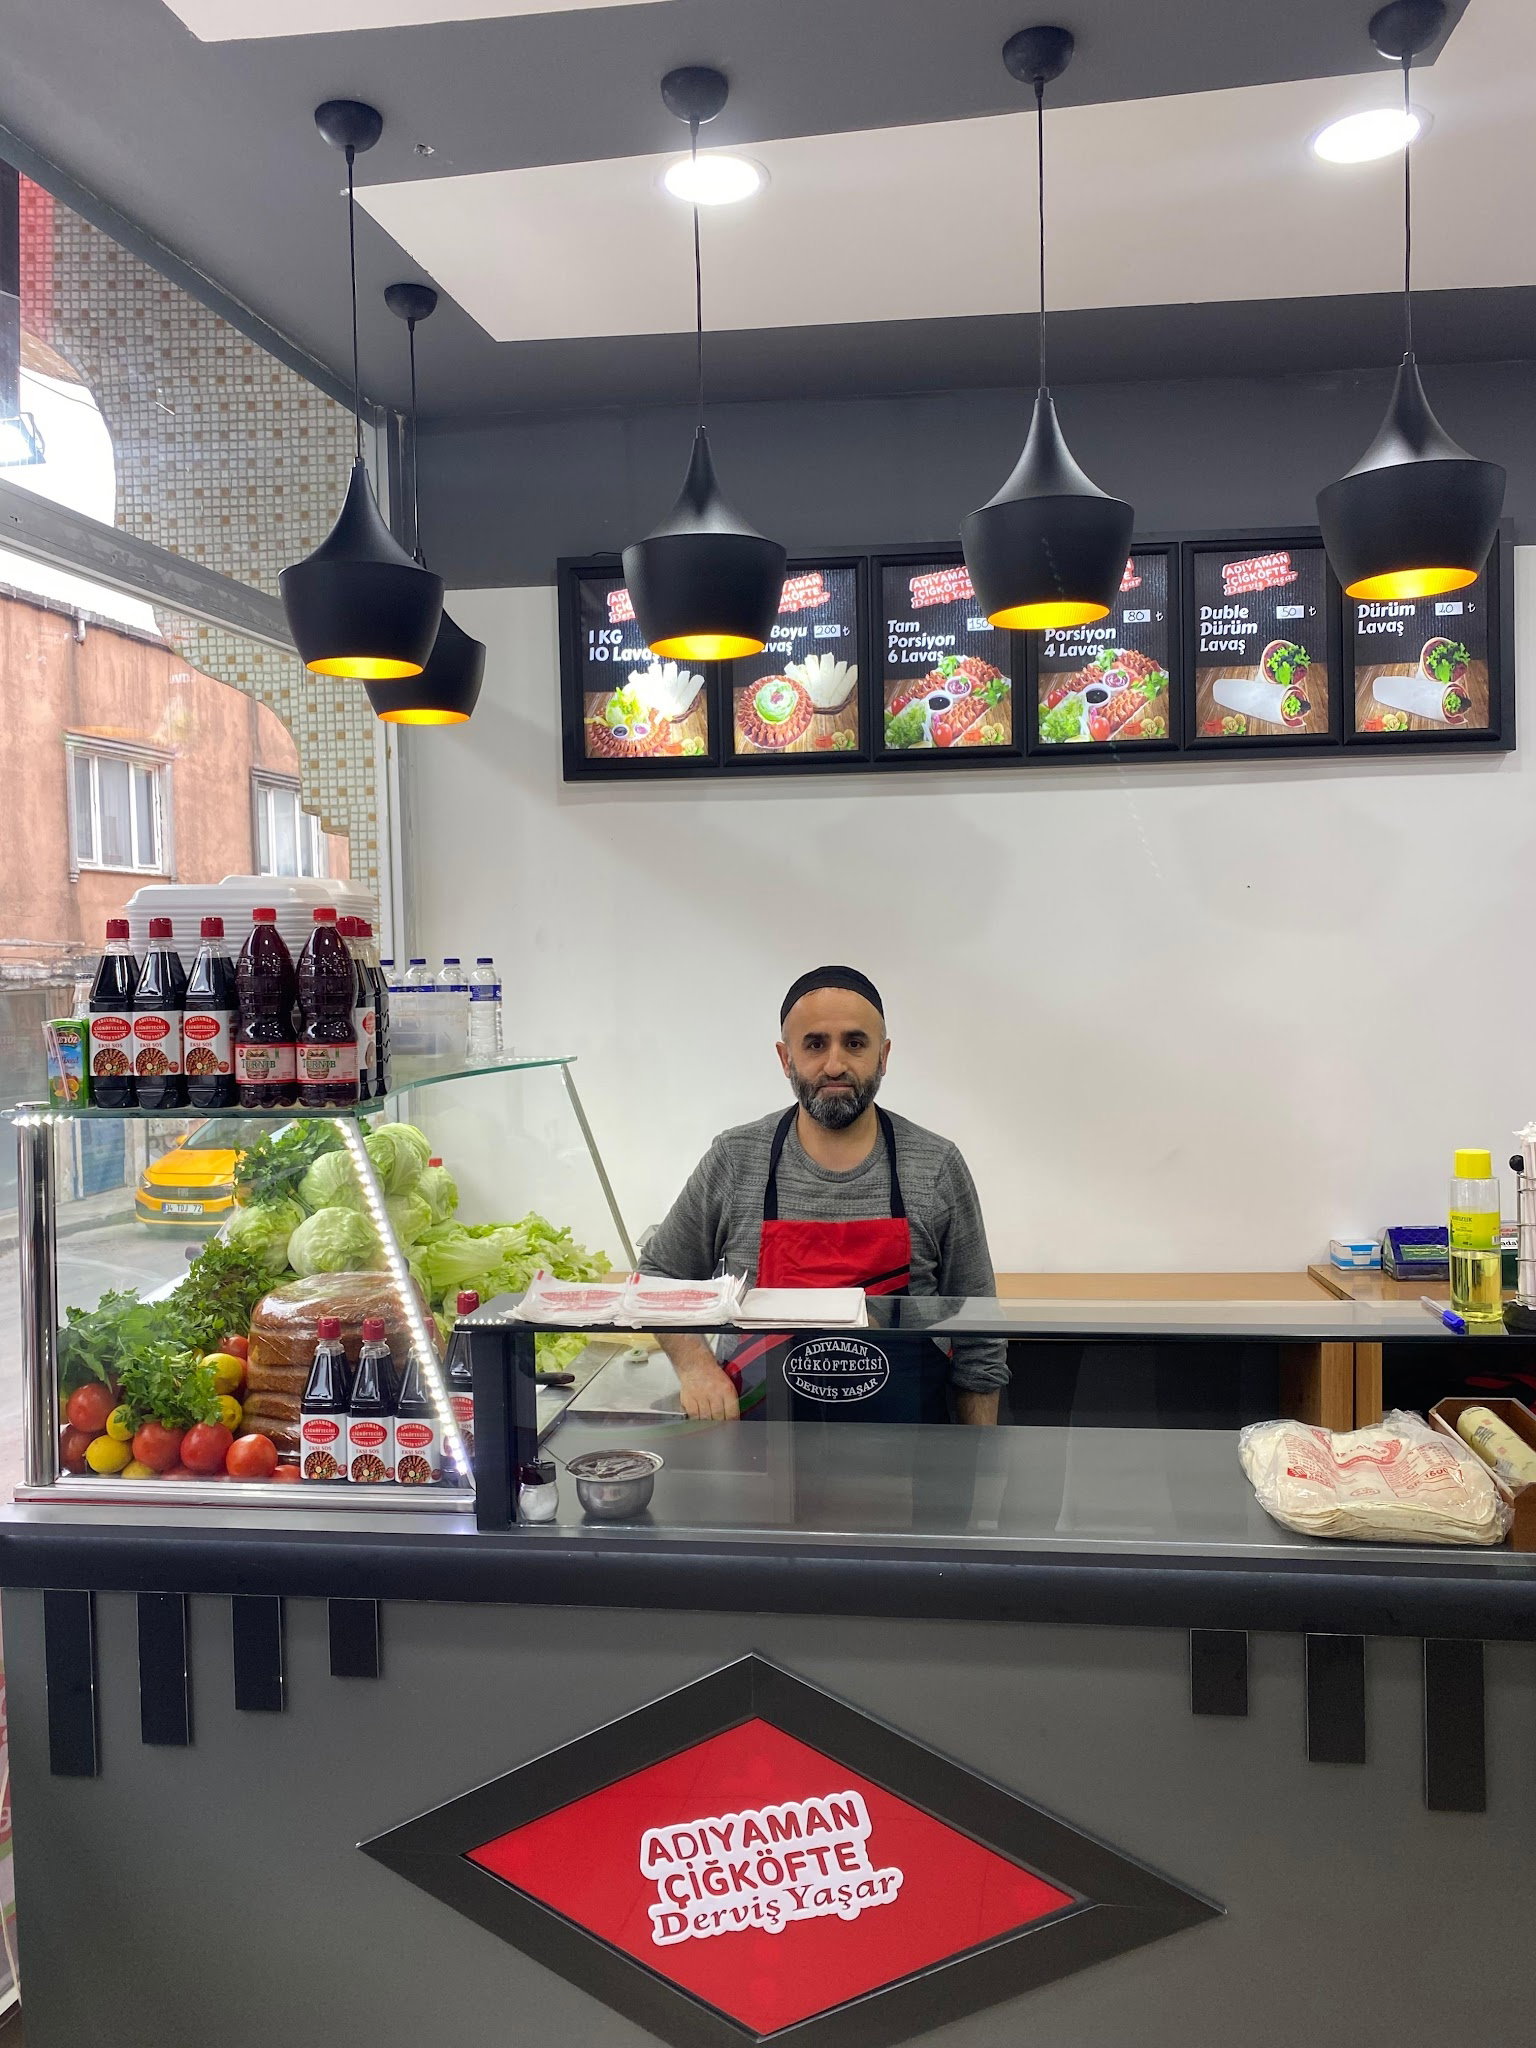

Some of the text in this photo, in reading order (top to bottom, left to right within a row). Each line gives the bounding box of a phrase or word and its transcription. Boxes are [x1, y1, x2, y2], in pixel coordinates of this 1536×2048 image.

[1226, 554, 1288, 576] ADIYAMAN
[1127, 611, 1145, 621] 80
[1200, 604, 1249, 620] Duble
[1281, 607, 1297, 617] 50
[1357, 602, 1416, 619] Dürüm
[770, 625, 808, 640] Boyu
[815, 626, 837, 636] 200
[887, 619, 920, 633] Tam
[1200, 620, 1258, 636] Dürüm
[1357, 621, 1405, 637] Lavaş
[598, 629, 624, 645] KG
[887, 632, 956, 650] Porsiyon
[1044, 626, 1117, 643] Porsiyon
[1043, 643, 1056, 657] 4
[1200, 638, 1246, 655] Lavaş
[887, 649, 899, 663] 6
[804, 1341, 868, 1357] ADIYAMAN
[790, 1356, 883, 1372] ÇİĞKÖFTECİSİ
[795, 1376, 879, 1399] DERVİŞ YAŞAR
[647, 1799, 860, 1867] ADIYAMAN
[664, 1841, 862, 1910] ÇİĞKÖFTE
[655, 1874, 897, 1940] Derviş Yaşar
